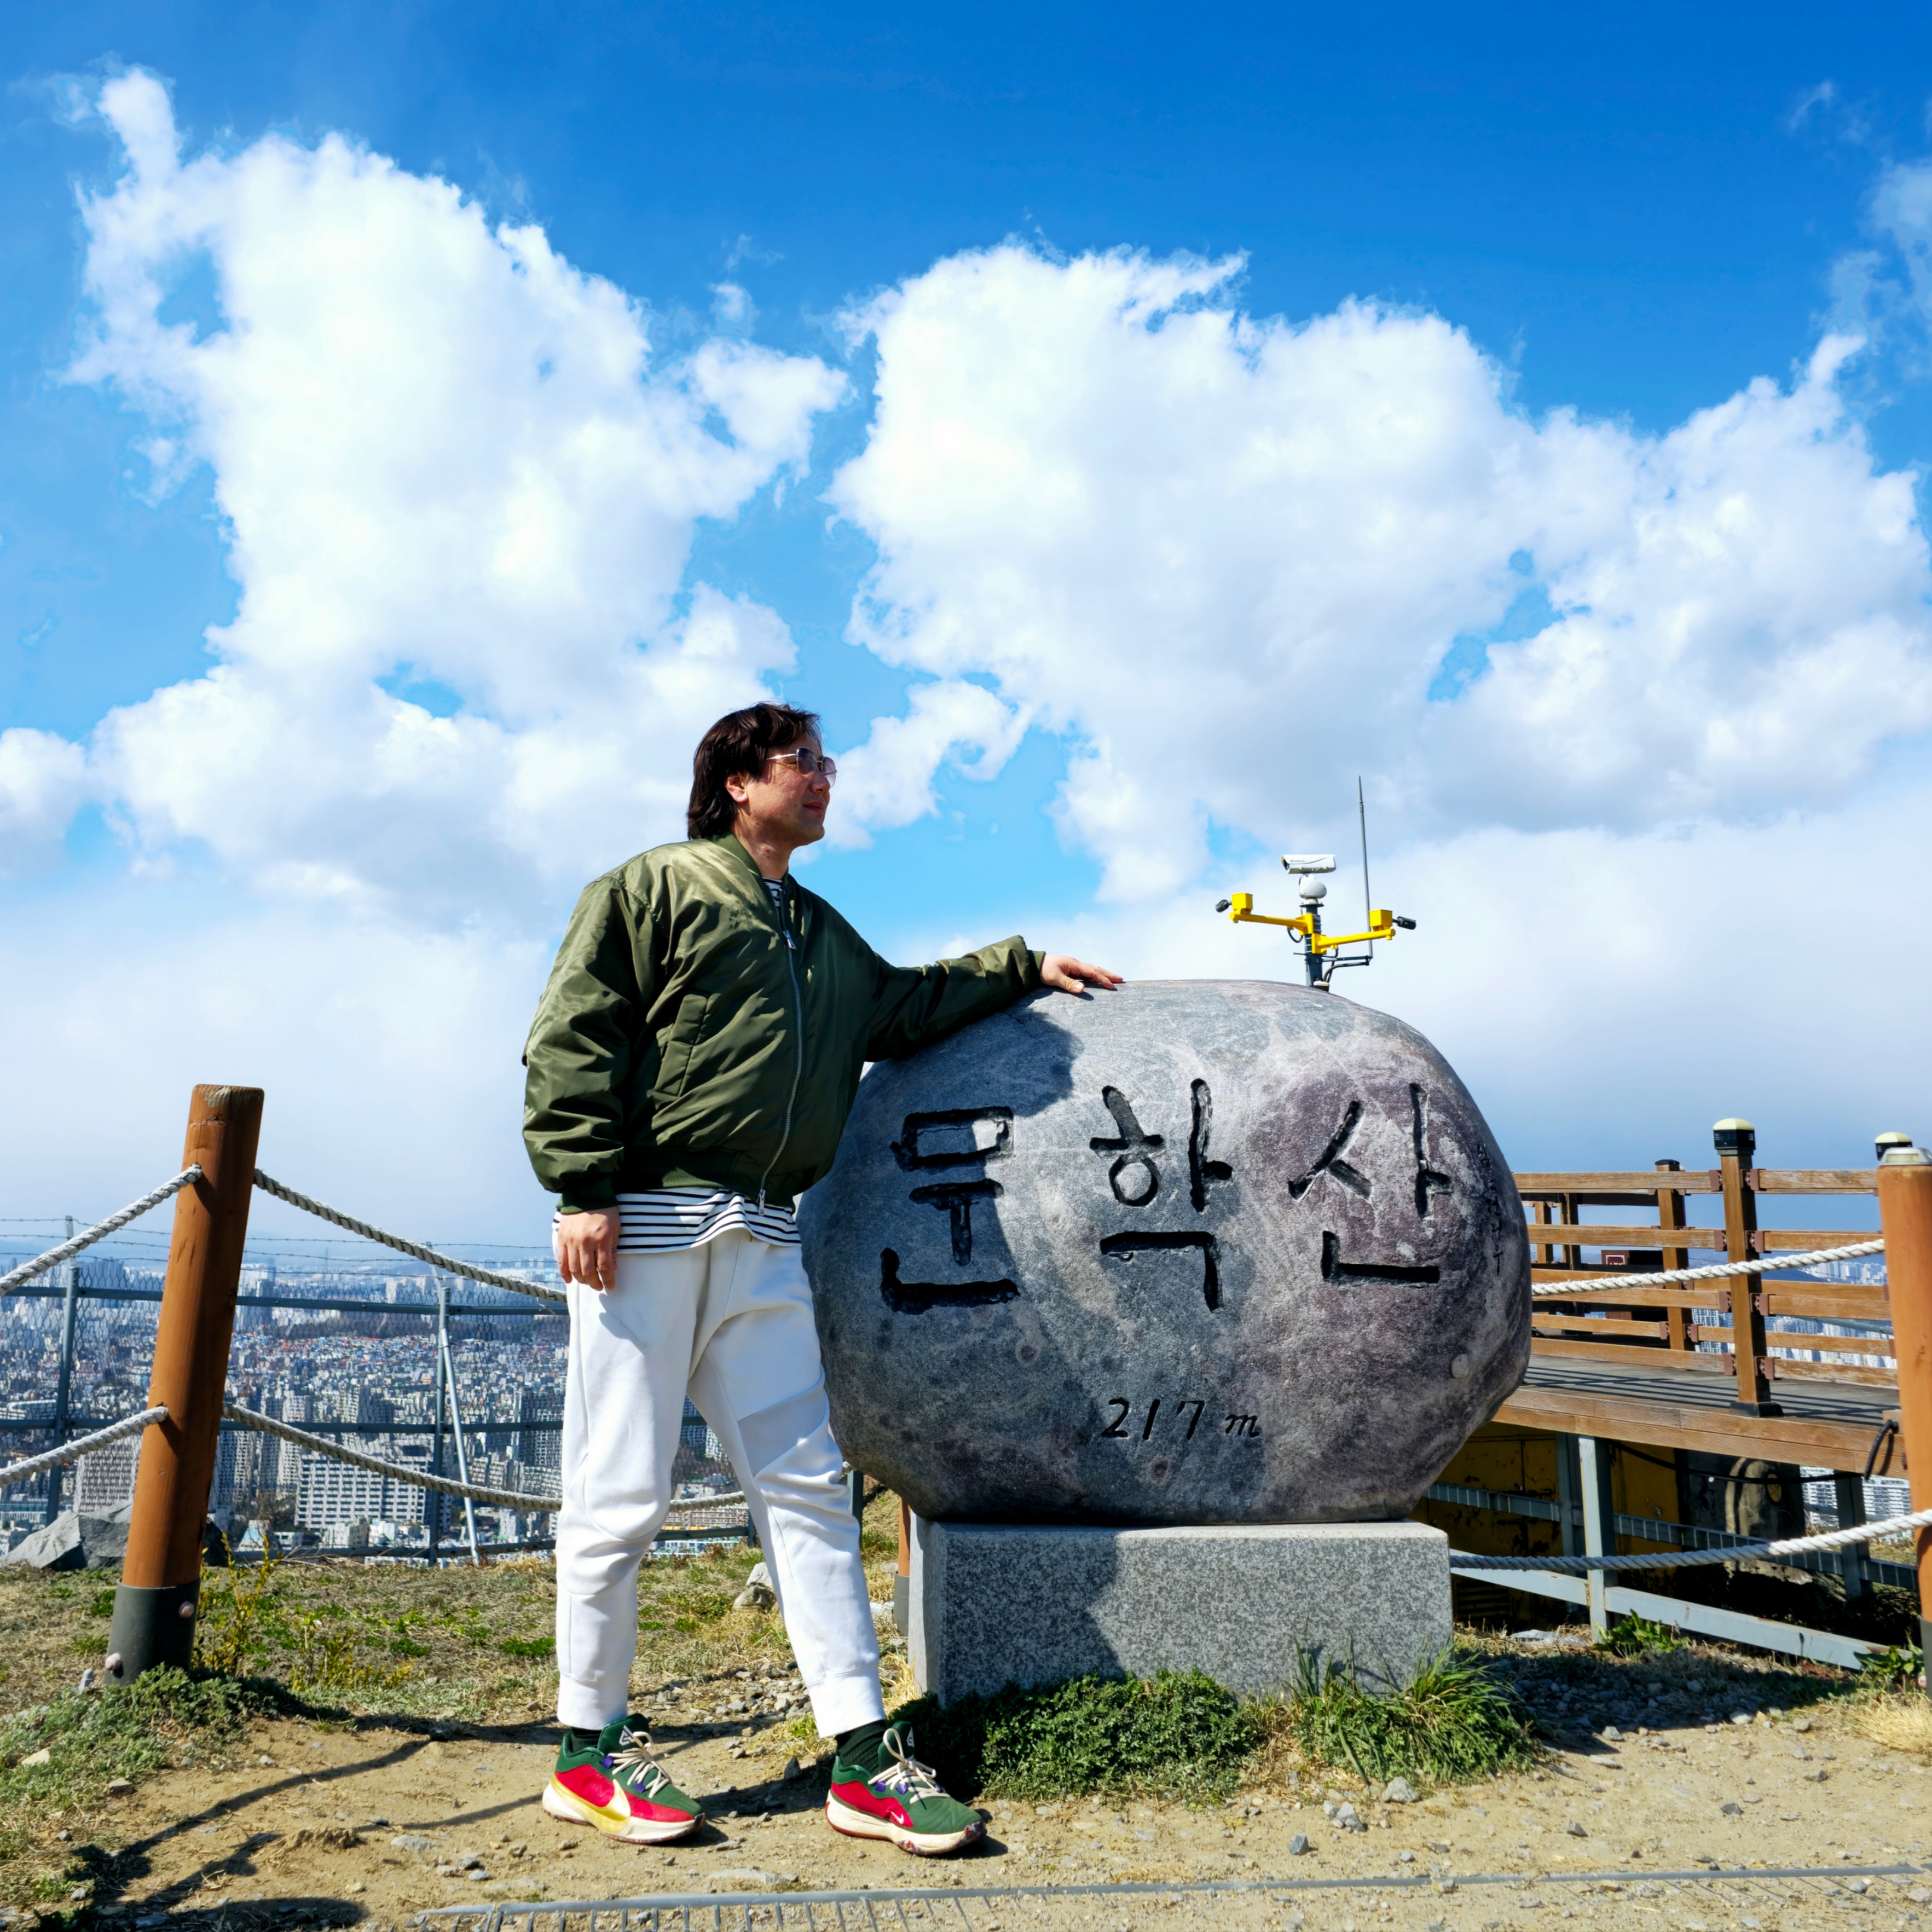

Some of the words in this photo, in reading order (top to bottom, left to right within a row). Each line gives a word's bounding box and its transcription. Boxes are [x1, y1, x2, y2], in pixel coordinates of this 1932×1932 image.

[880, 1078, 1452, 1314] 문학산
[1100, 1397, 1206, 1441] 217
[1224, 1414, 1260, 1438] m
